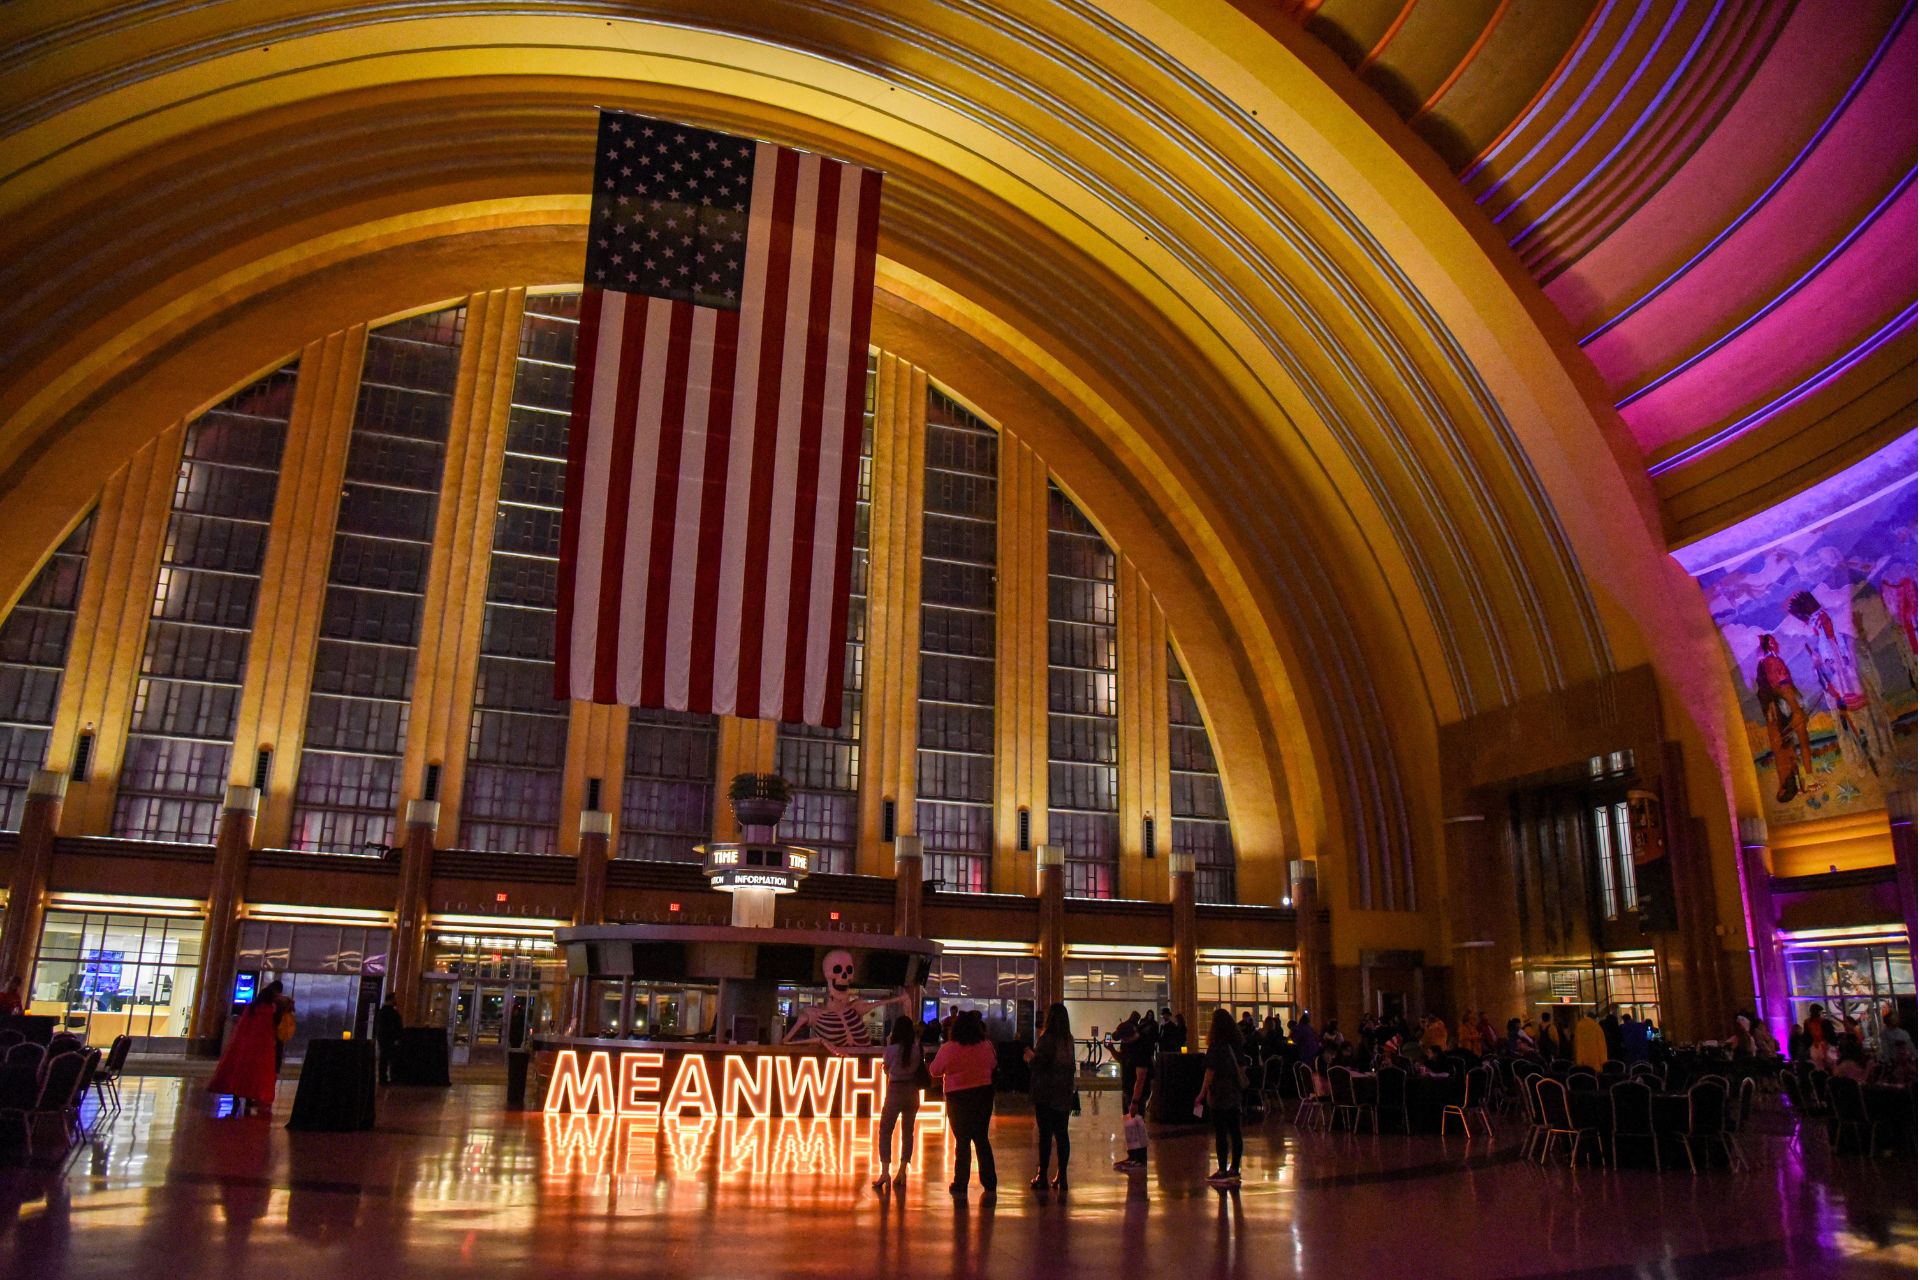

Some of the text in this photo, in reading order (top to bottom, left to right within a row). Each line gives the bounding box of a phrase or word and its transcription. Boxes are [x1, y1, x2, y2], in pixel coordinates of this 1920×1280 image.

[714, 851, 738, 864] TIME
[789, 855, 807, 869] TIME
[734, 875, 786, 886] INFORMATION
